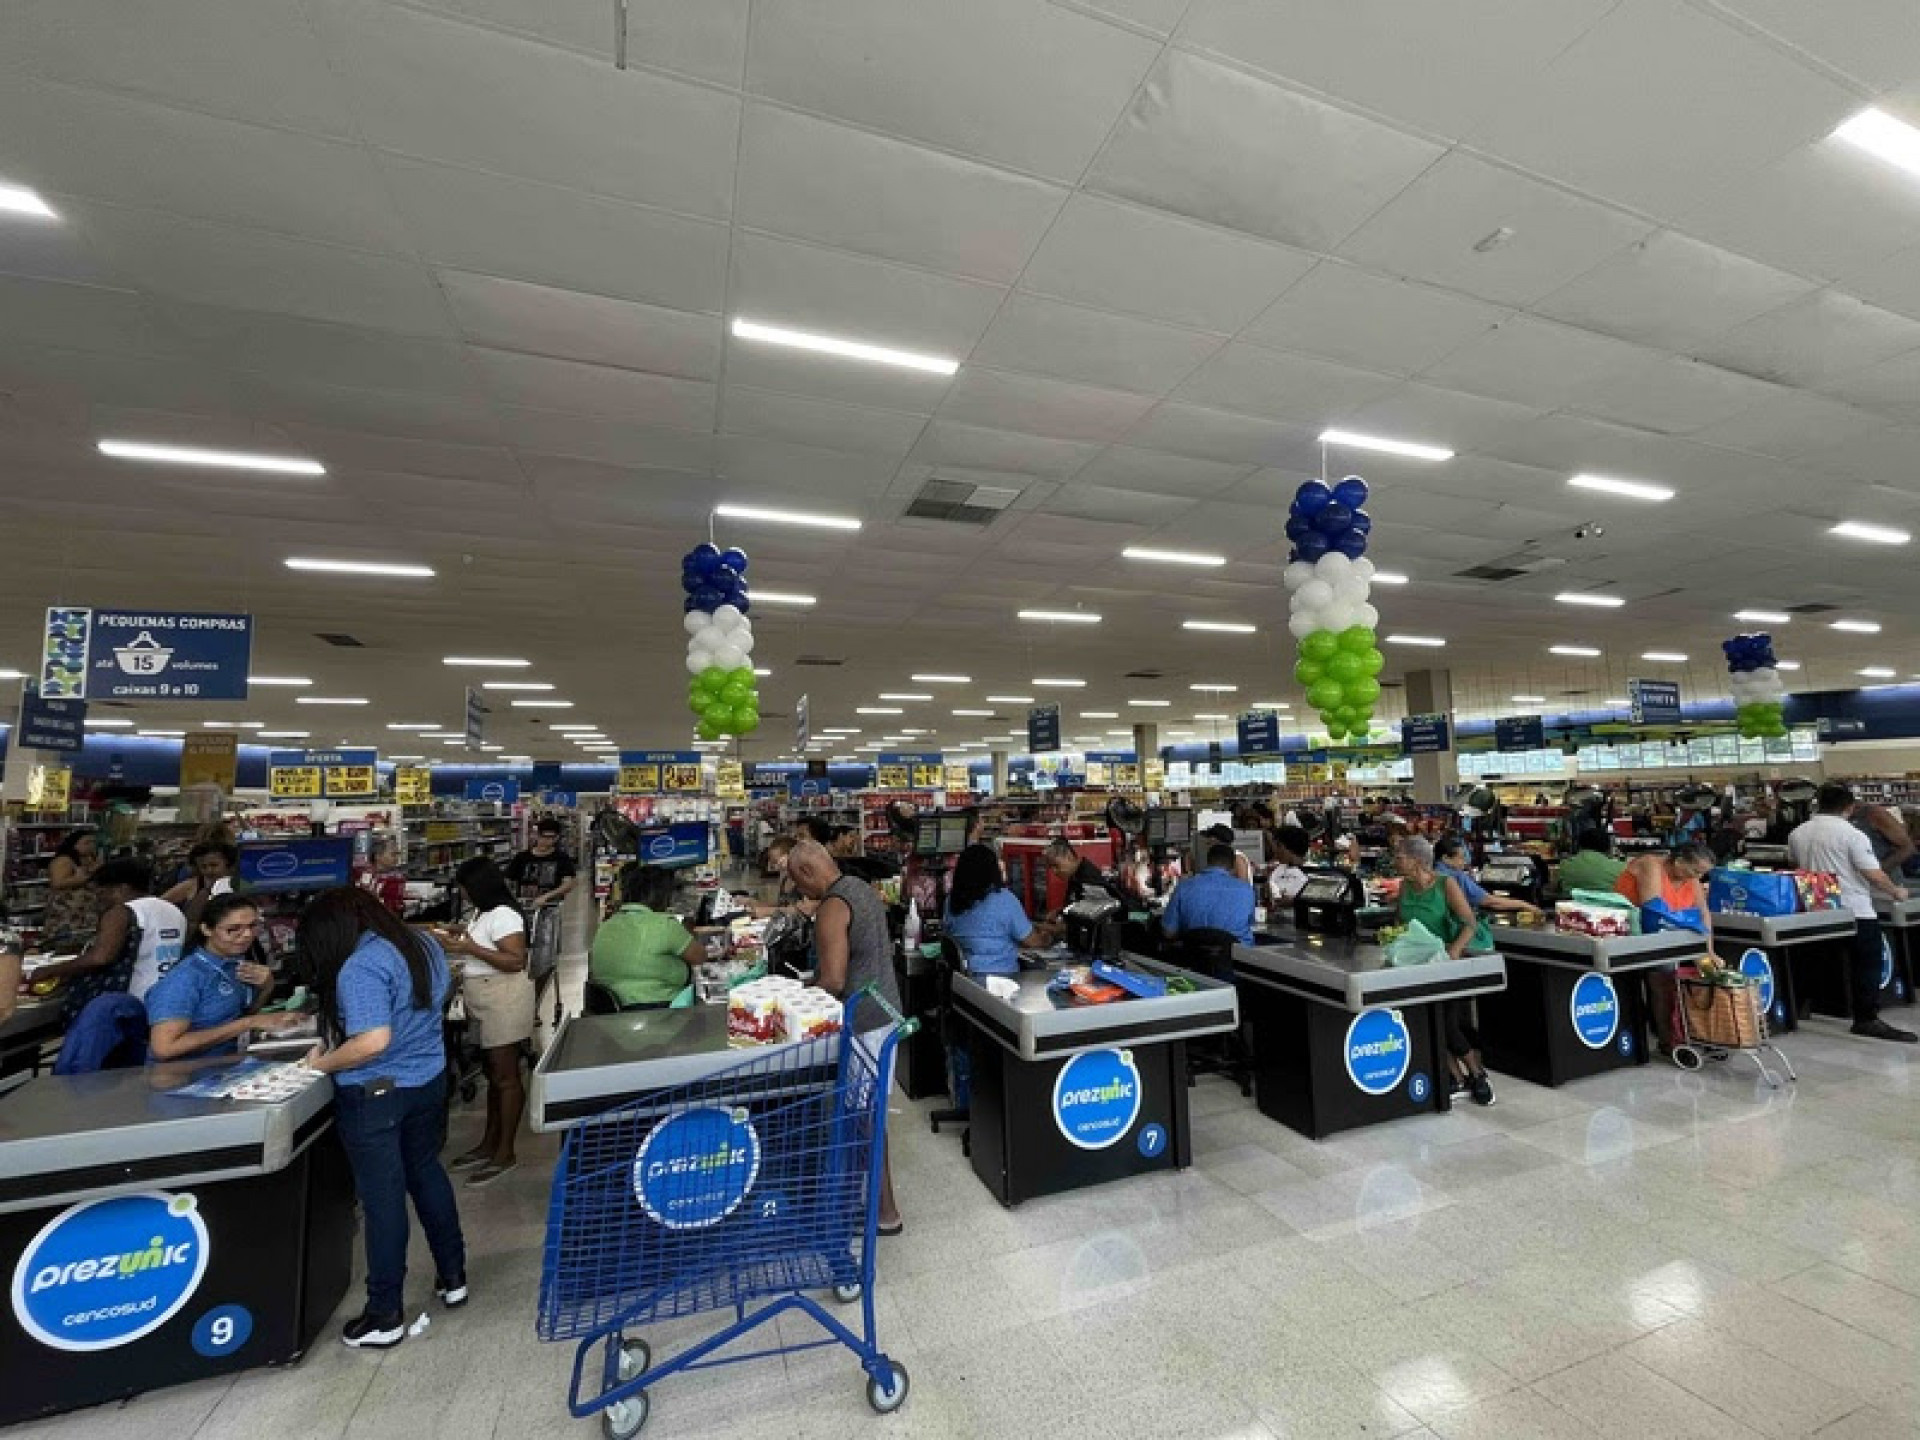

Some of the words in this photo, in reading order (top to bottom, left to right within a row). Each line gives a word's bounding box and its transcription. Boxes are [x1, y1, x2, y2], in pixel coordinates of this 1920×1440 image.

[98, 614, 175, 629] PEQUENAS
[179, 617, 246, 631] COMPRAS
[132, 654, 154, 671] 15
[172, 660, 219, 671] volumes
[113, 683, 156, 695] caixas
[160, 684, 169, 695] 9
[172, 687, 181, 695] e
[184, 684, 200, 696] 10
[1060, 1076, 1133, 1110] prezunic
[1146, 1129, 1158, 1151] 7
[31, 1235, 191, 1293] prezunic
[62, 1295, 157, 1327] cencosud
[210, 1316, 235, 1346] 9
